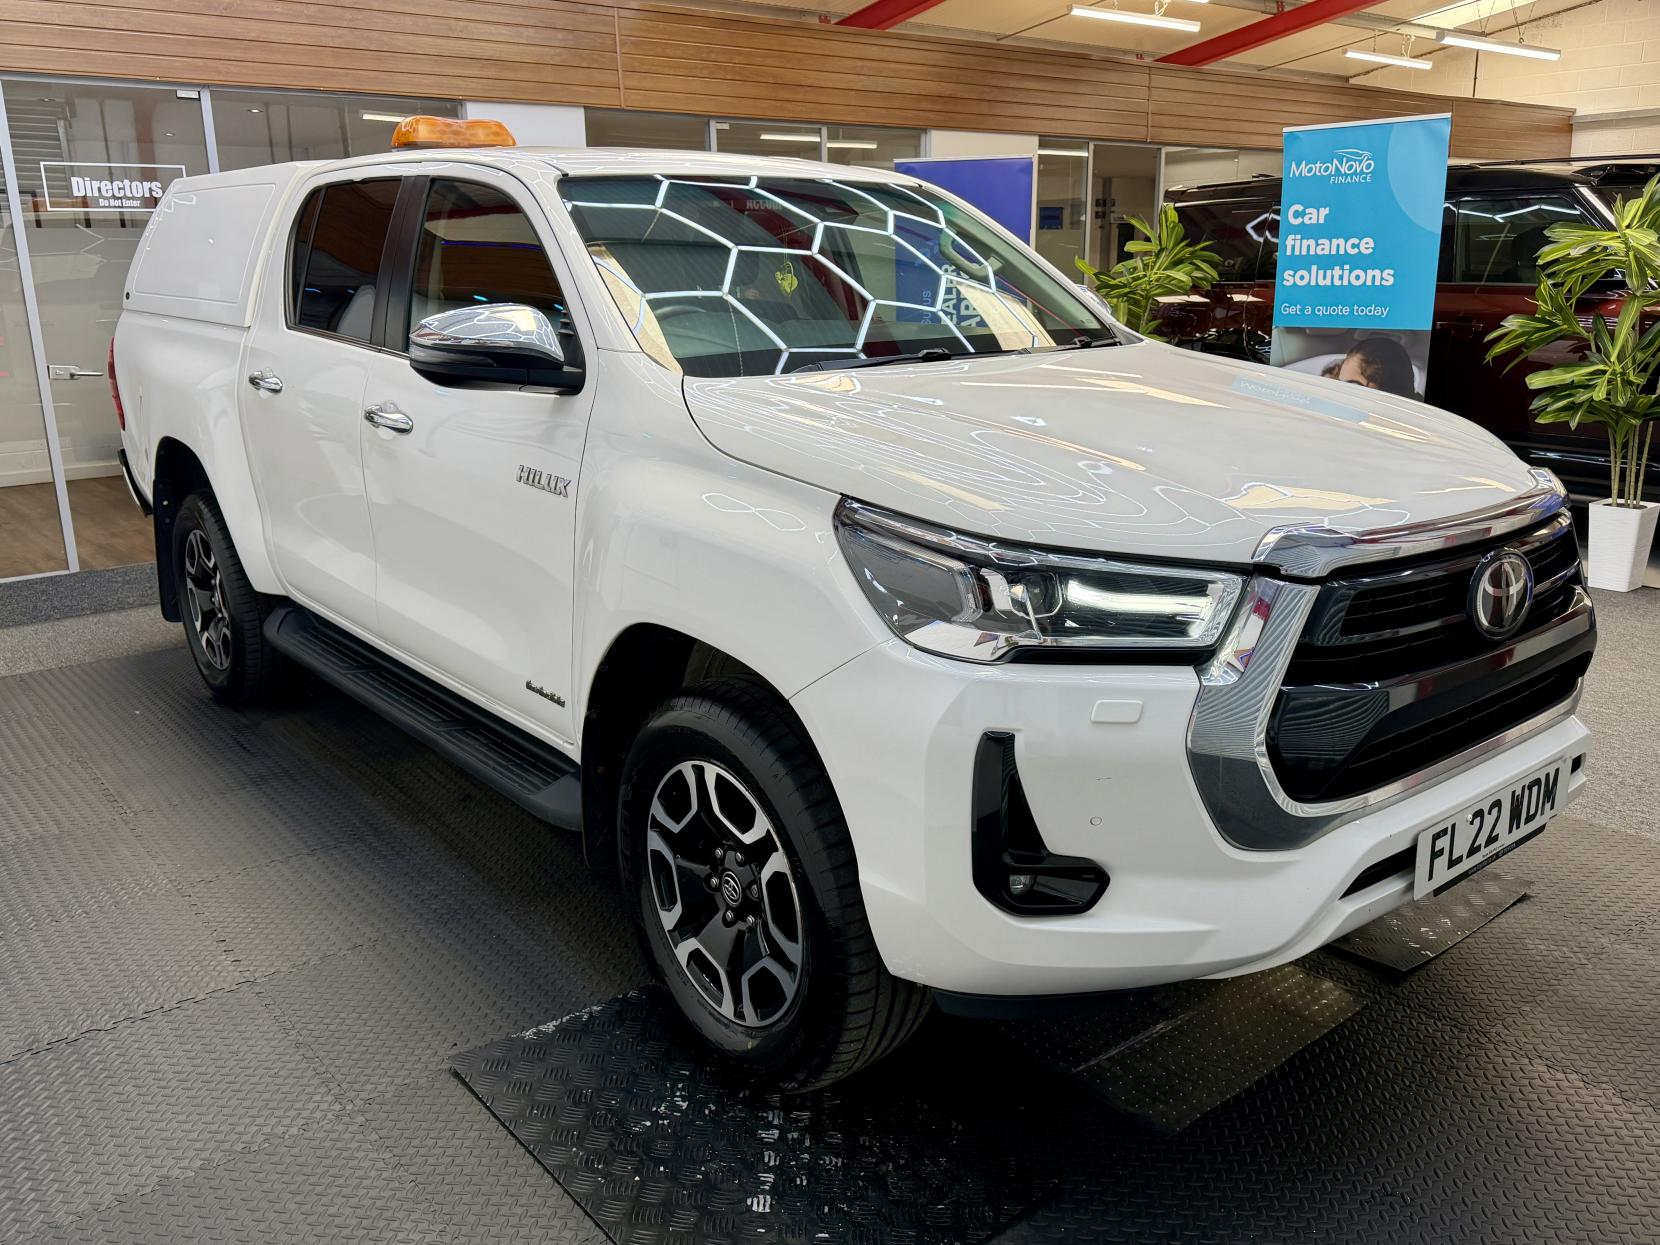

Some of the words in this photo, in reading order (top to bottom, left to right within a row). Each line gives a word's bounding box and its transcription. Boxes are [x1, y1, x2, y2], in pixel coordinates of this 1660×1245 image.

[1290, 156, 1375, 178] MotoNovo
[71, 176, 163, 198] Directors
[1330, 174, 1373, 184] FINANCE
[99, 198, 109, 207] Do
[110, 199, 122, 207] Not
[123, 199, 140, 207] Enter
[1287, 204, 1329, 225] Car
[1285, 234, 1375, 256] finance
[1283, 265, 1394, 286] solutions
[1281, 303, 1301, 315] Get
[1304, 306, 1312, 315] a
[1315, 305, 1350, 317] quote
[1353, 304, 1389, 318] today
[516, 464, 572, 498] HILUX
[1428, 799, 1502, 881] FL22
[1508, 767, 1561, 834] WDM
